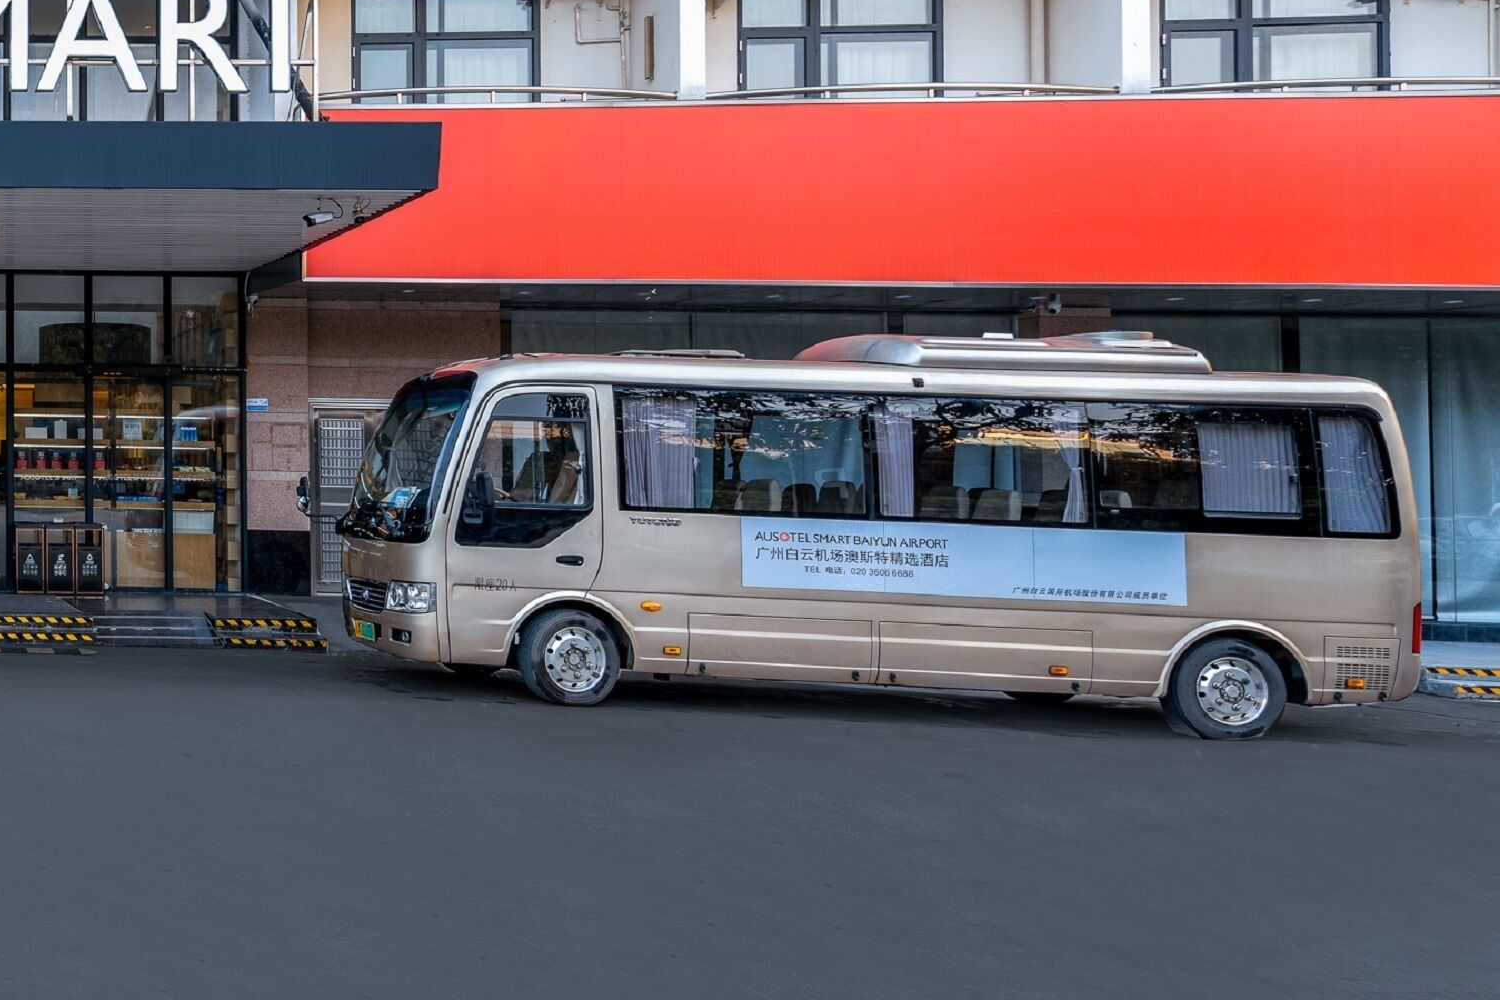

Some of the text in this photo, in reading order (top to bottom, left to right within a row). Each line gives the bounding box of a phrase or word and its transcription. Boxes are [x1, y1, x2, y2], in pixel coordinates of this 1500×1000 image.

[754, 530, 949, 549] AUSOTEL SMART BAIYUN AIRPORT
[755, 547, 949, 568] 广州白云机场澳斯特精选酒店
[804, 565, 821, 574] TEL
[850, 567, 866, 575] 020
